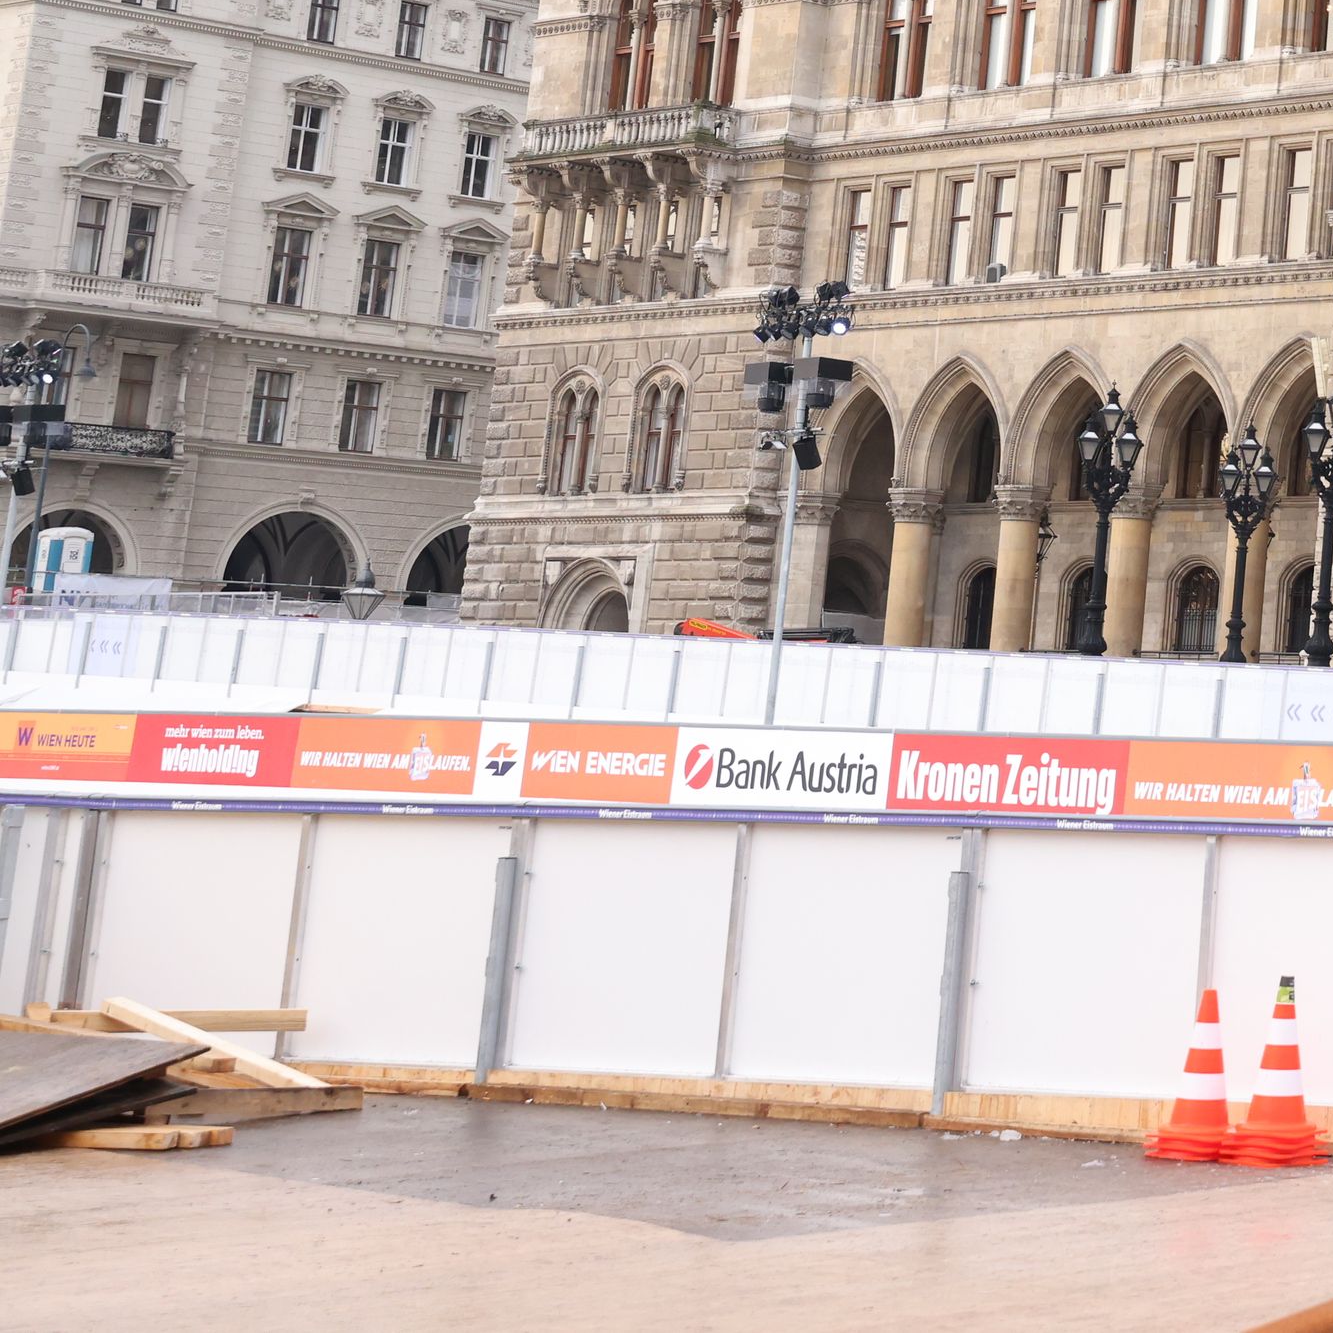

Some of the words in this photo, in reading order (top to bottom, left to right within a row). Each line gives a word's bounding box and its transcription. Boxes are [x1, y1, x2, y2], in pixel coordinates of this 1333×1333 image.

[37, 734, 62, 747] WIEN
[64, 734, 96, 748] HEUTE
[165, 724, 190, 738] mehr
[191, 724, 212, 738] wien
[214, 728, 235, 739] zum
[236, 725, 265, 740] leben.
[300, 751, 322, 766] WIR
[322, 752, 362, 768] HALTEN
[363, 753, 390, 769] WIEN
[390, 754, 410, 770] AM
[531, 749, 581, 772] WIEN
[585, 750, 666, 777] ENERGIE
[715, 747, 783, 791] Bank
[786, 751, 878, 796] Austria
[896, 749, 999, 804] Kronen
[1002, 752, 1117, 815] Zeitung
[1134, 781, 1163, 800] WIR
[1165, 783, 1219, 803] HALTEN
[1223, 785, 1262, 805] WIEN
[1263, 786, 1289, 806] AM
[1300, 826, 1326, 836] Wiener
